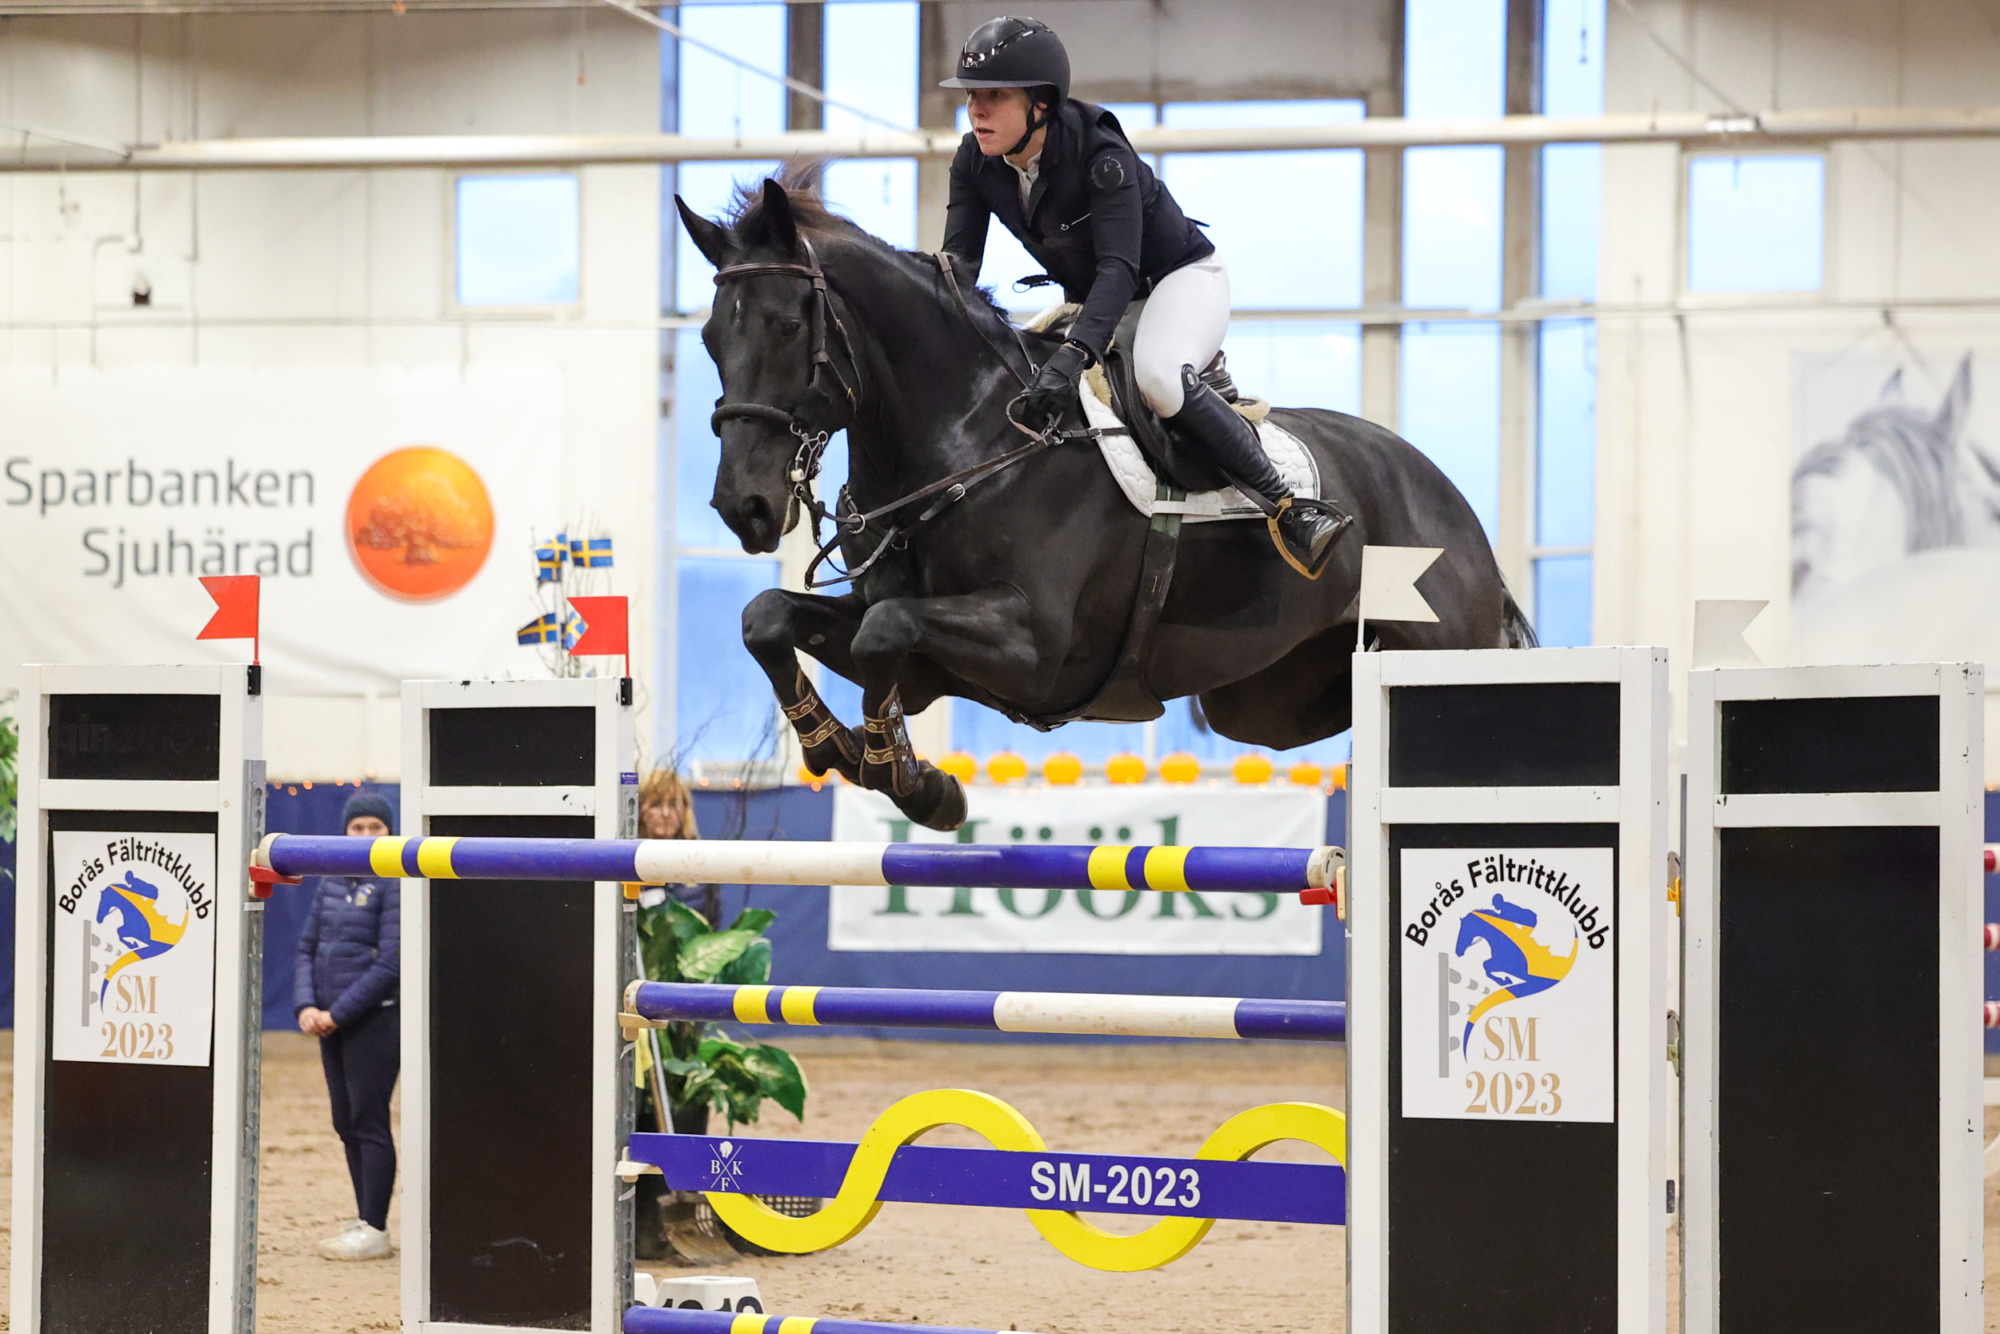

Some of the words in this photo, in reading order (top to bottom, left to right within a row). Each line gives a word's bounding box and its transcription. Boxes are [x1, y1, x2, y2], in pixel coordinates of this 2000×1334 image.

[4, 456, 316, 518] Sparbanken
[81, 526, 314, 590] Sjuhärad
[58, 857, 105, 915] Borås
[106, 836, 213, 920] Fältrittklubb
[1404, 877, 1465, 947] Borås
[1467, 853, 1610, 950] Fältrittklubb
[115, 974, 159, 1014] SM
[100, 1021, 174, 1060] 2023
[1483, 1015, 1541, 1062] SM
[1464, 1070, 1563, 1116] 2023
[1030, 1160, 1201, 1209] SM-2023
